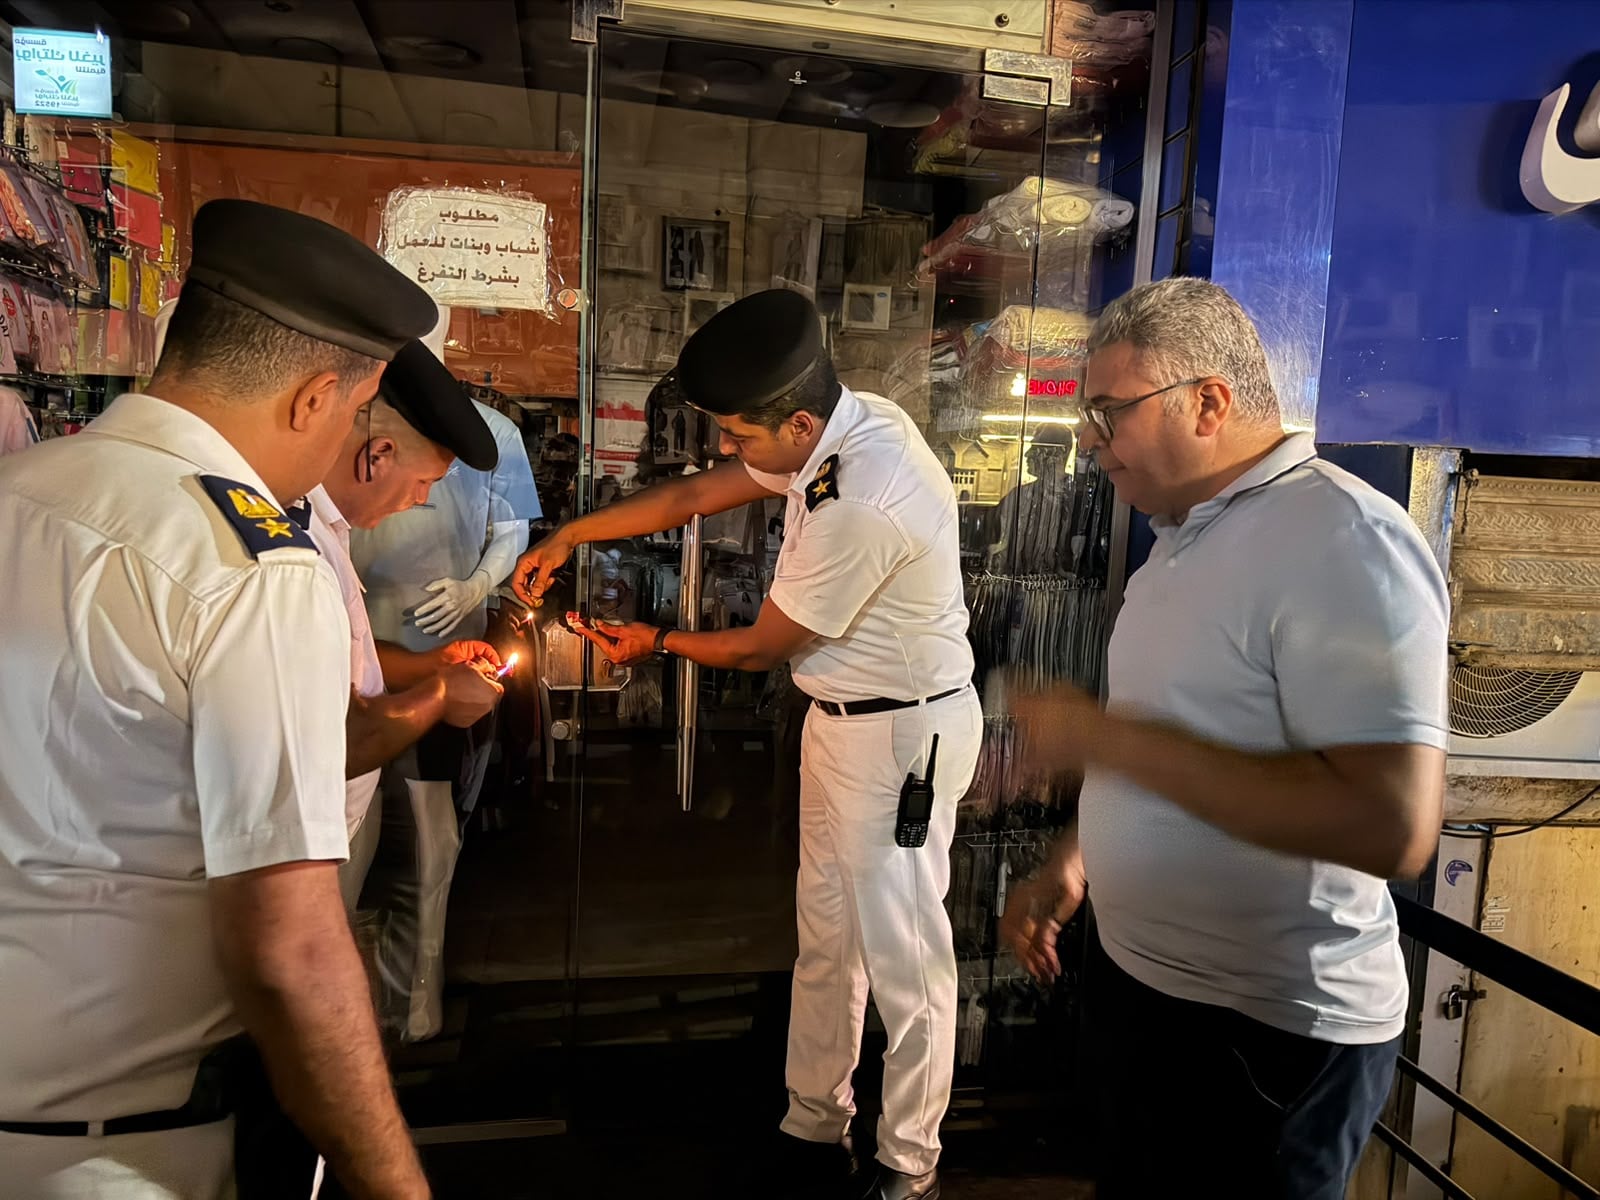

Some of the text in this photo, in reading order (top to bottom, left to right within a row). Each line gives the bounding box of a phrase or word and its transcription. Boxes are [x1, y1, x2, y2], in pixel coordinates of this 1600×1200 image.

[439, 208, 500, 223] مطلوب
[396, 234, 540, 258] شباب وبنات للعمل
[417, 261, 520, 288] بشرط التفرغ
